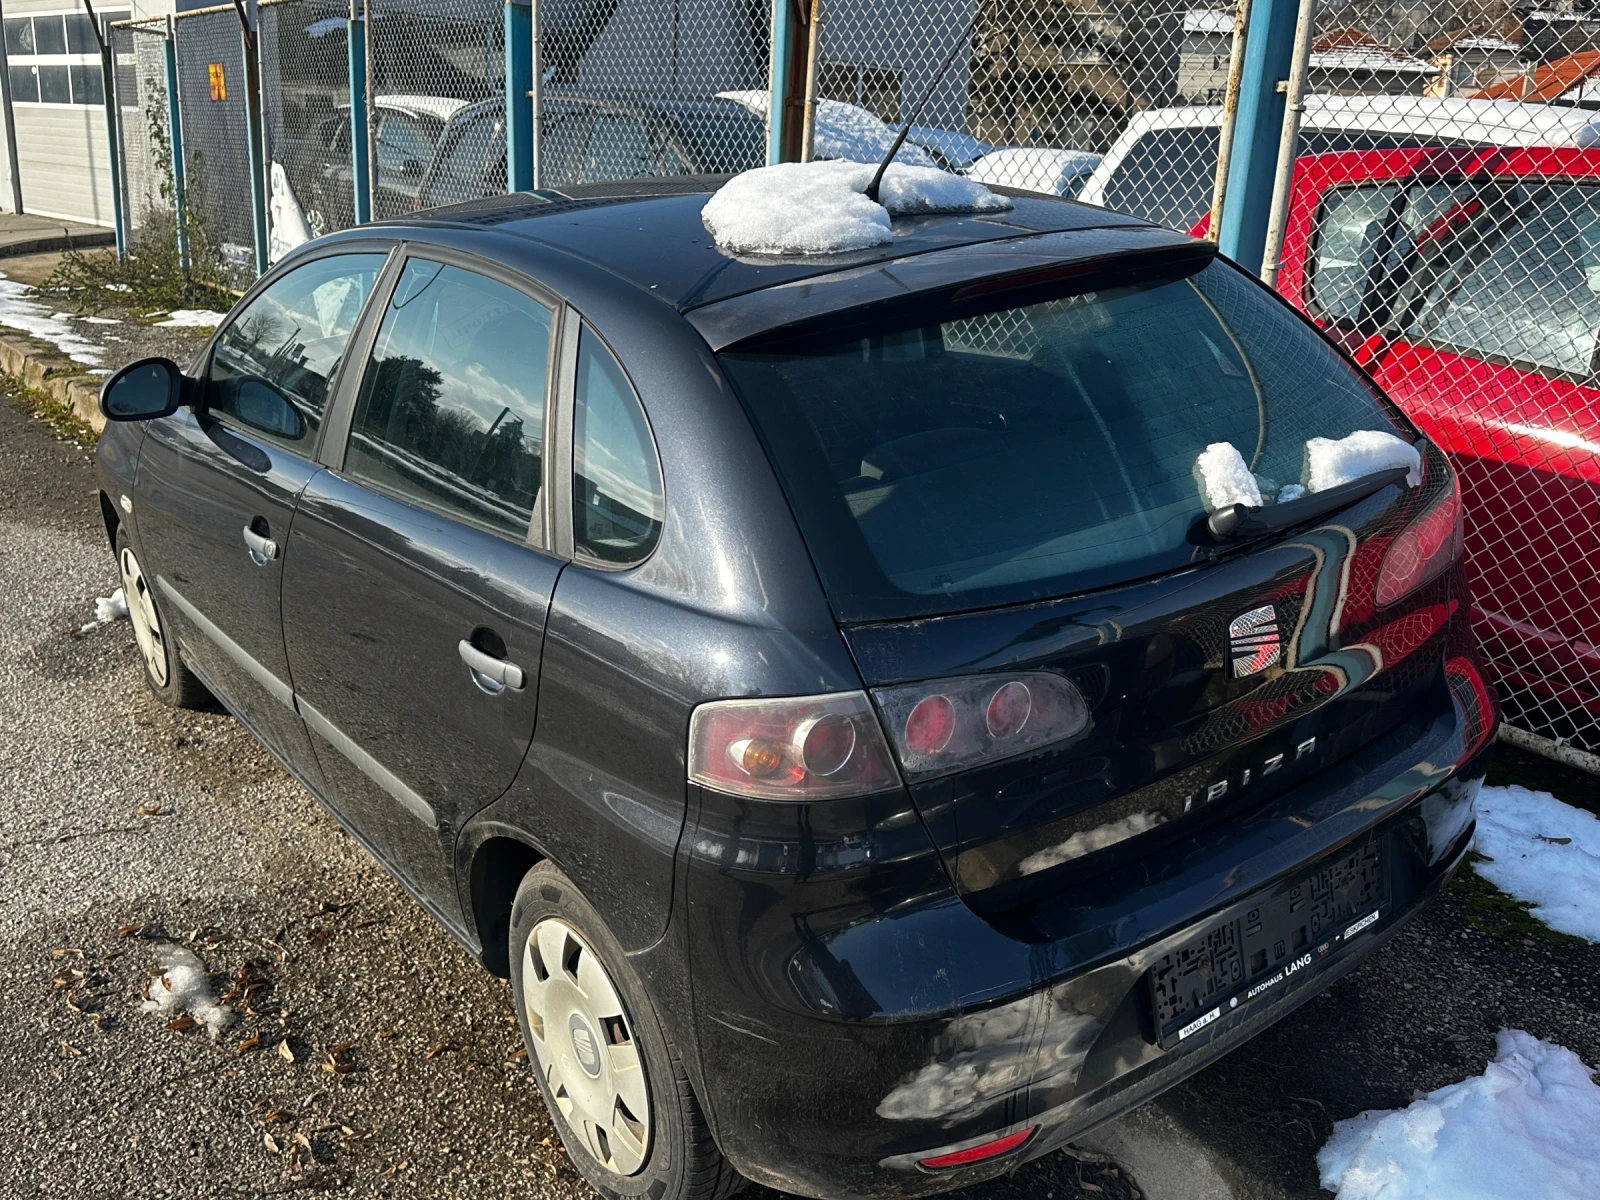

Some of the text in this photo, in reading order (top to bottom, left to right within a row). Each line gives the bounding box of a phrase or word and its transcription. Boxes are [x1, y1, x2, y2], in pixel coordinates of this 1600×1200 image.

[1184, 736, 1316, 812] IBIZA
[1247, 953, 1312, 999] AUTOHAUS LANG
[1183, 1019, 1202, 1036] HAAG
